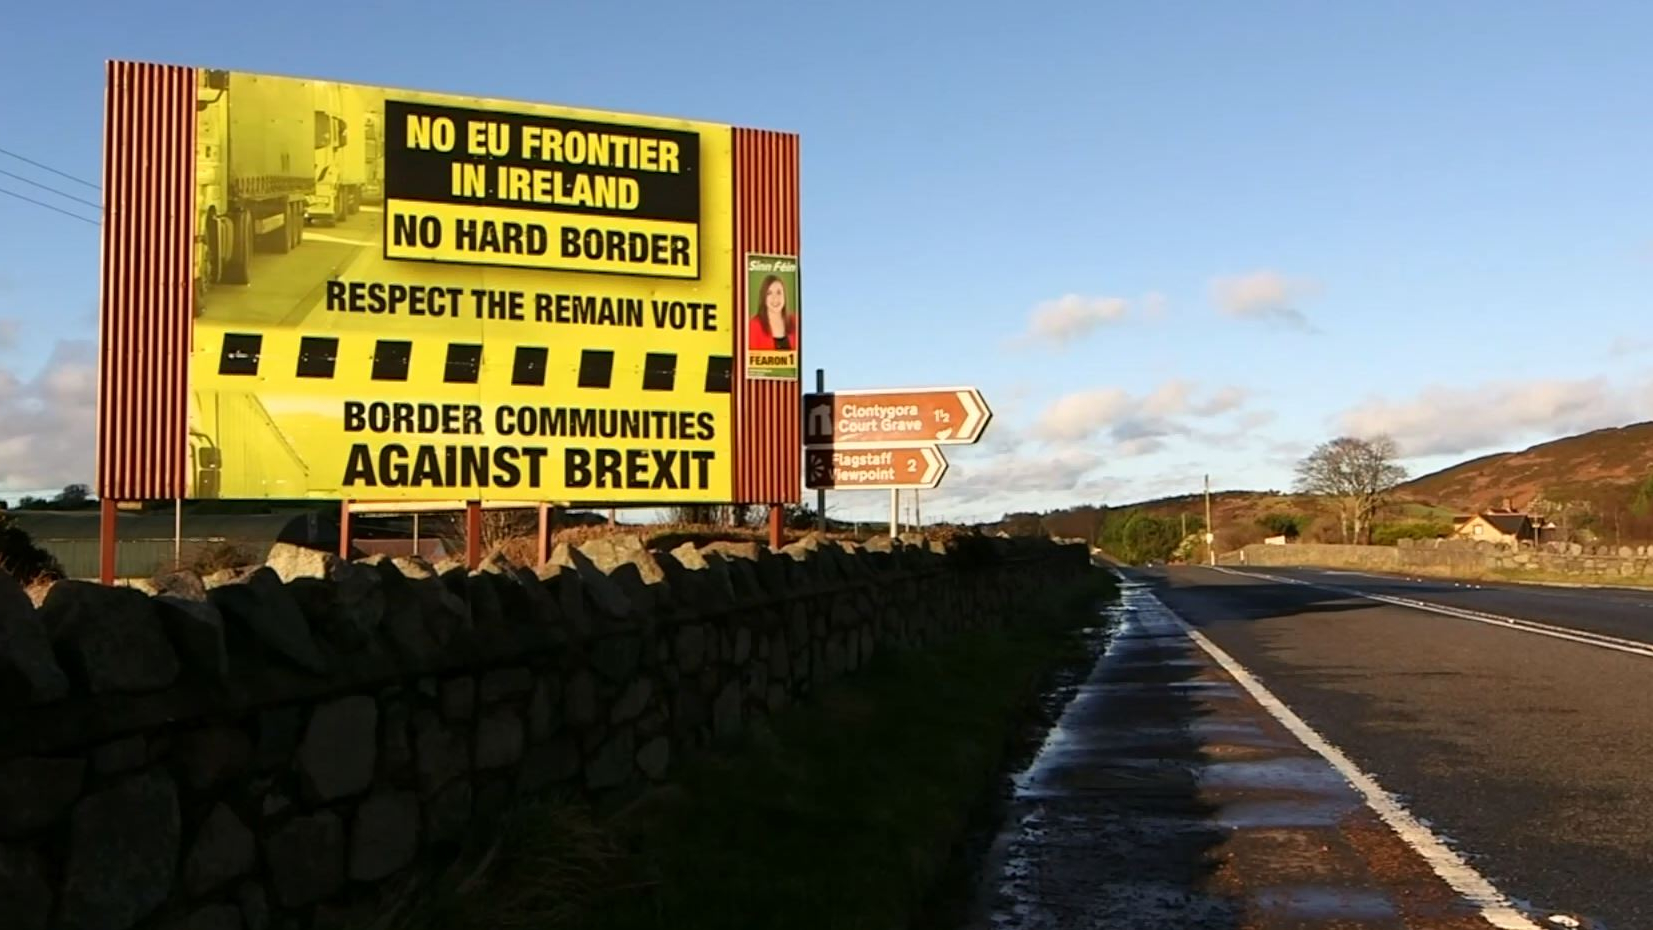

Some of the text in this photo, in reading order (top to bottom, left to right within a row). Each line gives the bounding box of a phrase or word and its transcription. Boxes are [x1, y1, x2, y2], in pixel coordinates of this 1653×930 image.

[406, 114, 680, 174] NO EU FRONTIER
[451, 162, 640, 211] IN IRELAND
[393, 214, 691, 267] NO HARD BORDER
[749, 260, 773, 272] Sinn
[326, 279, 718, 332] RESPECT THE REMAIN VOTE
[749, 353, 795, 366] FEARON 1
[343, 401, 715, 440] BORDER COMMUNITIES
[838, 418, 923, 433] Court Grave
[842, 404, 919, 420] Clontygora
[342, 443, 716, 490] AGAINST BREXIT
[907, 459, 918, 473] 2
